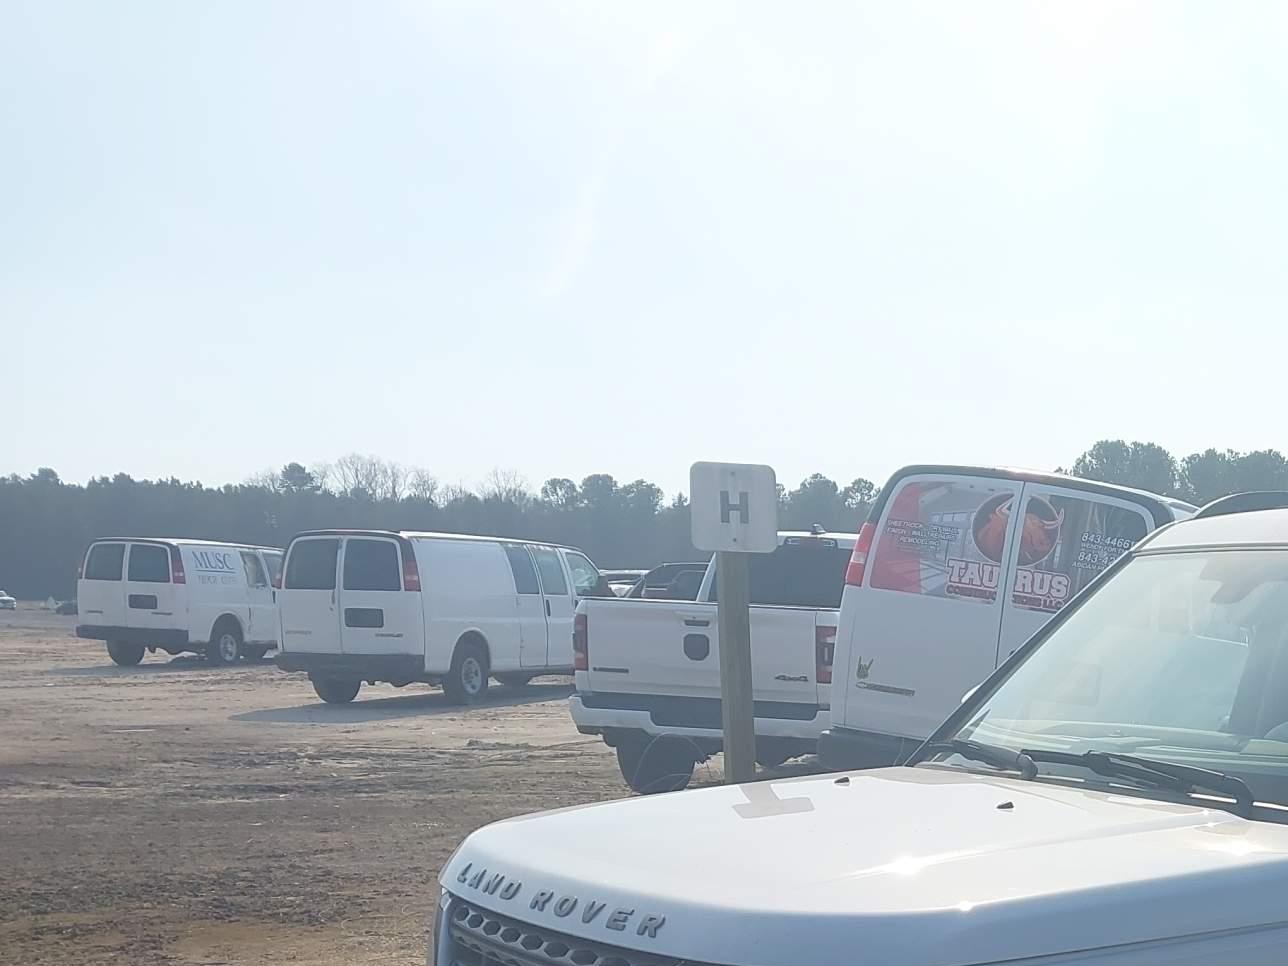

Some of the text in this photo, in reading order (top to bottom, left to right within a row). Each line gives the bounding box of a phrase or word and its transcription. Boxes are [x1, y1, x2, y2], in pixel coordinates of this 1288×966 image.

[720, 490, 749, 524] H
[192, 551, 234, 570] MUSC
[456, 863, 666, 939] LAND ROVER
